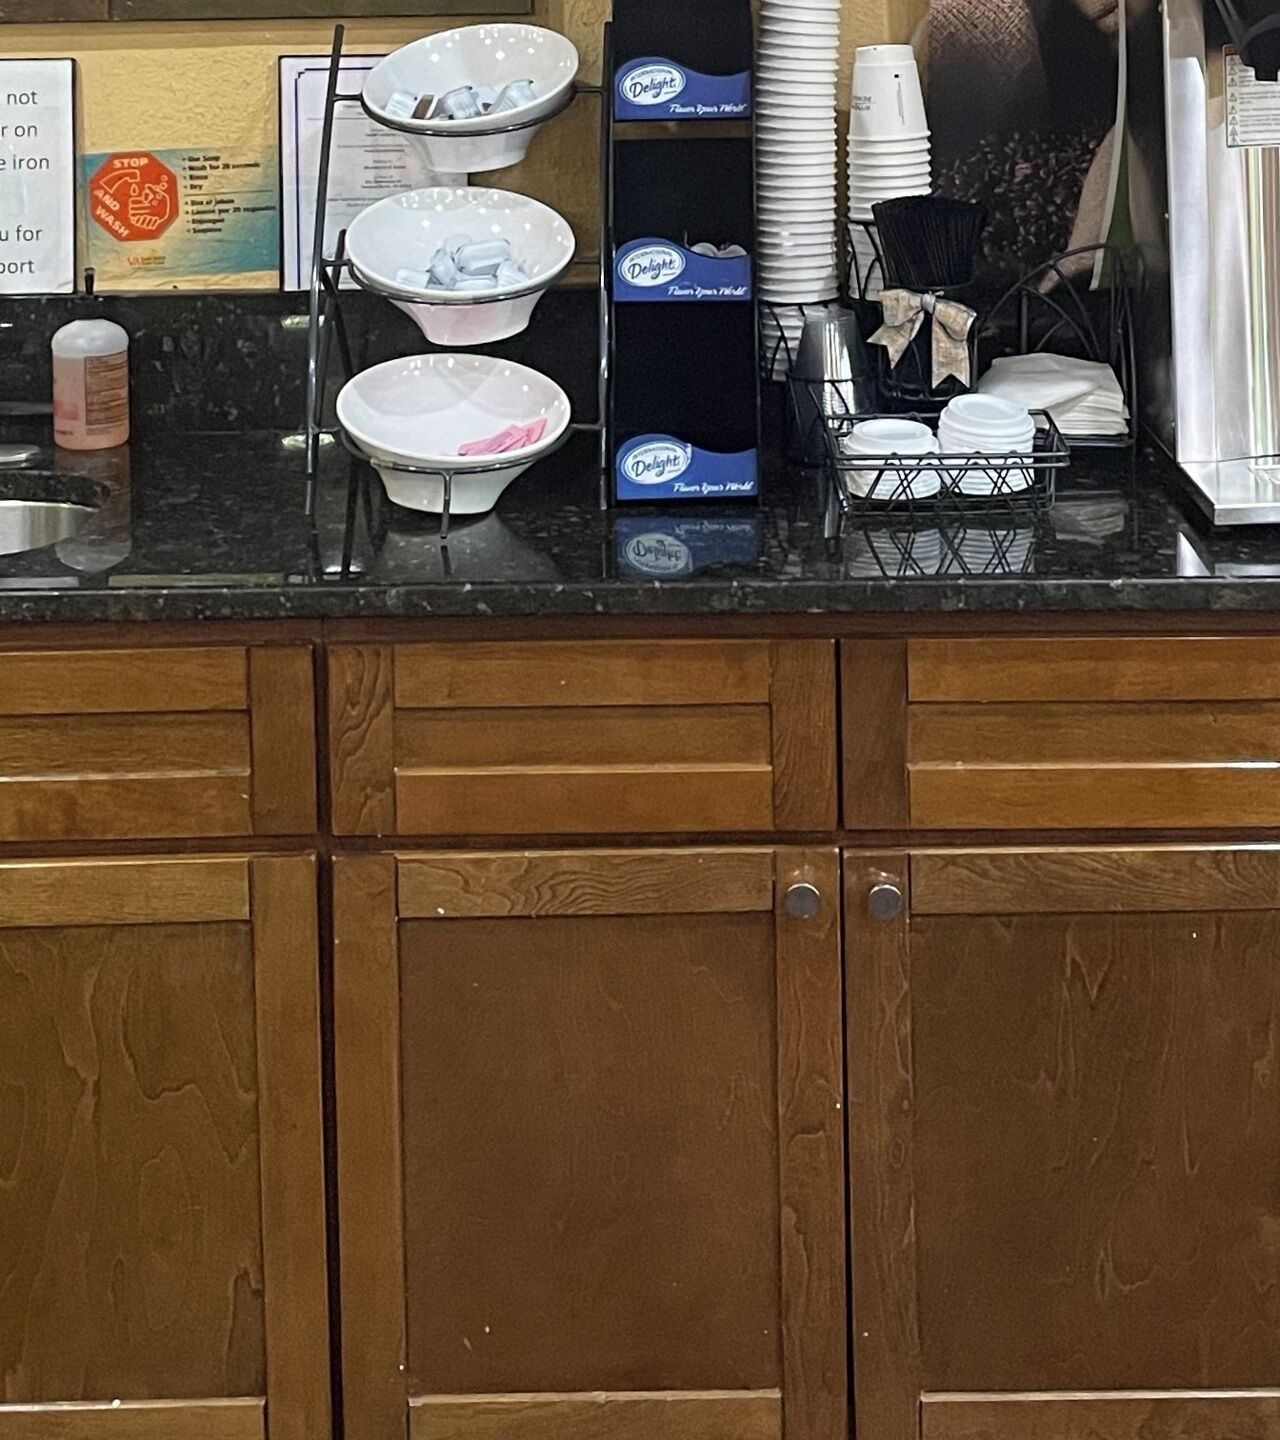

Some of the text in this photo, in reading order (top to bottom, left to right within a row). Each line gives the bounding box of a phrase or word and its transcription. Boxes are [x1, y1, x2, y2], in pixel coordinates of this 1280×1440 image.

[629, 76, 677, 99] Delight
[6, 91, 38, 105] not
[14, 124, 38, 138] on
[13, 154, 50, 170] iron
[113, 157, 149, 169] STOP
[189, 183, 203, 191] Dry
[94, 188, 120, 211] AND
[96, 205, 130, 238] WASH
[16, 224, 43, 242] for
[627, 258, 676, 280] Delight
[631, 454, 681, 477] Delight
